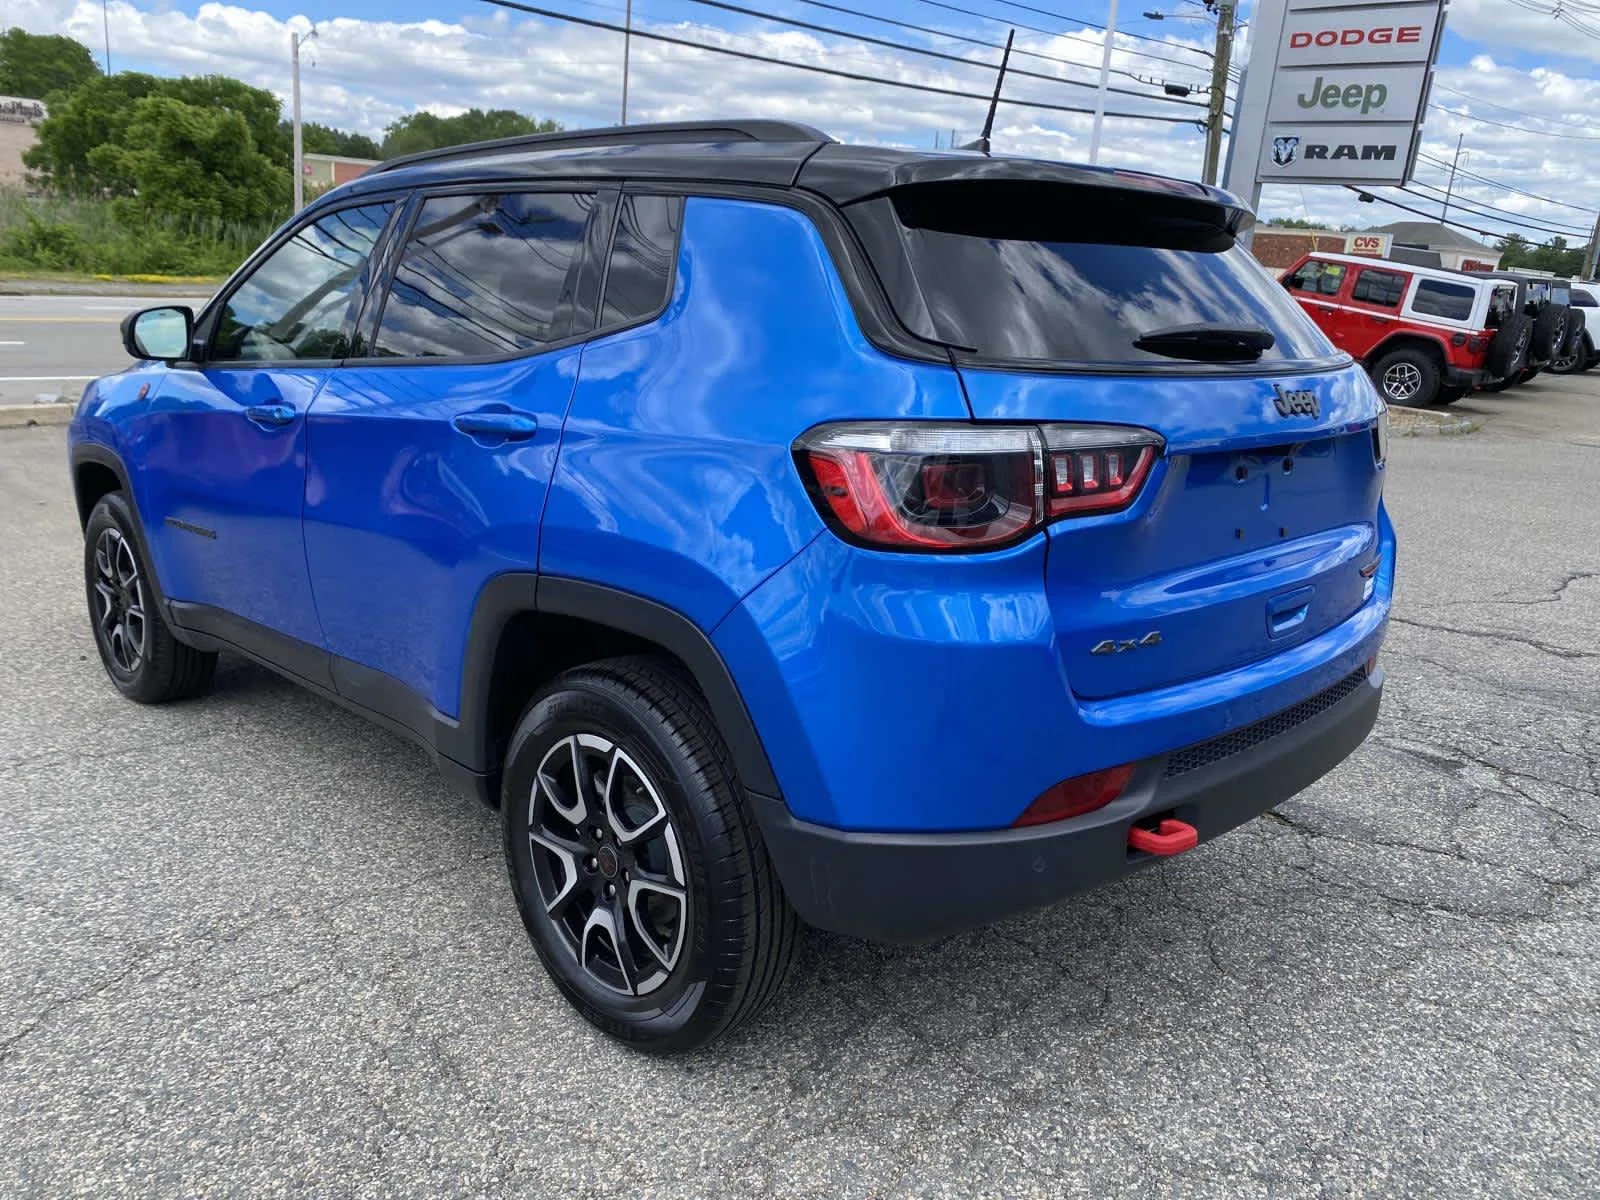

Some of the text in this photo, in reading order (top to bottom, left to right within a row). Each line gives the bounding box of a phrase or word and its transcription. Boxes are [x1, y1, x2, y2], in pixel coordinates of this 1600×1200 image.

[1290, 26, 1422, 48] DODGE
[1297, 76, 1388, 114] Jeep
[1304, 144, 1397, 161] RAM
[1354, 236, 1380, 248] CVS
[1272, 384, 1319, 420] Jeep
[1091, 631, 1162, 653] 4x4
